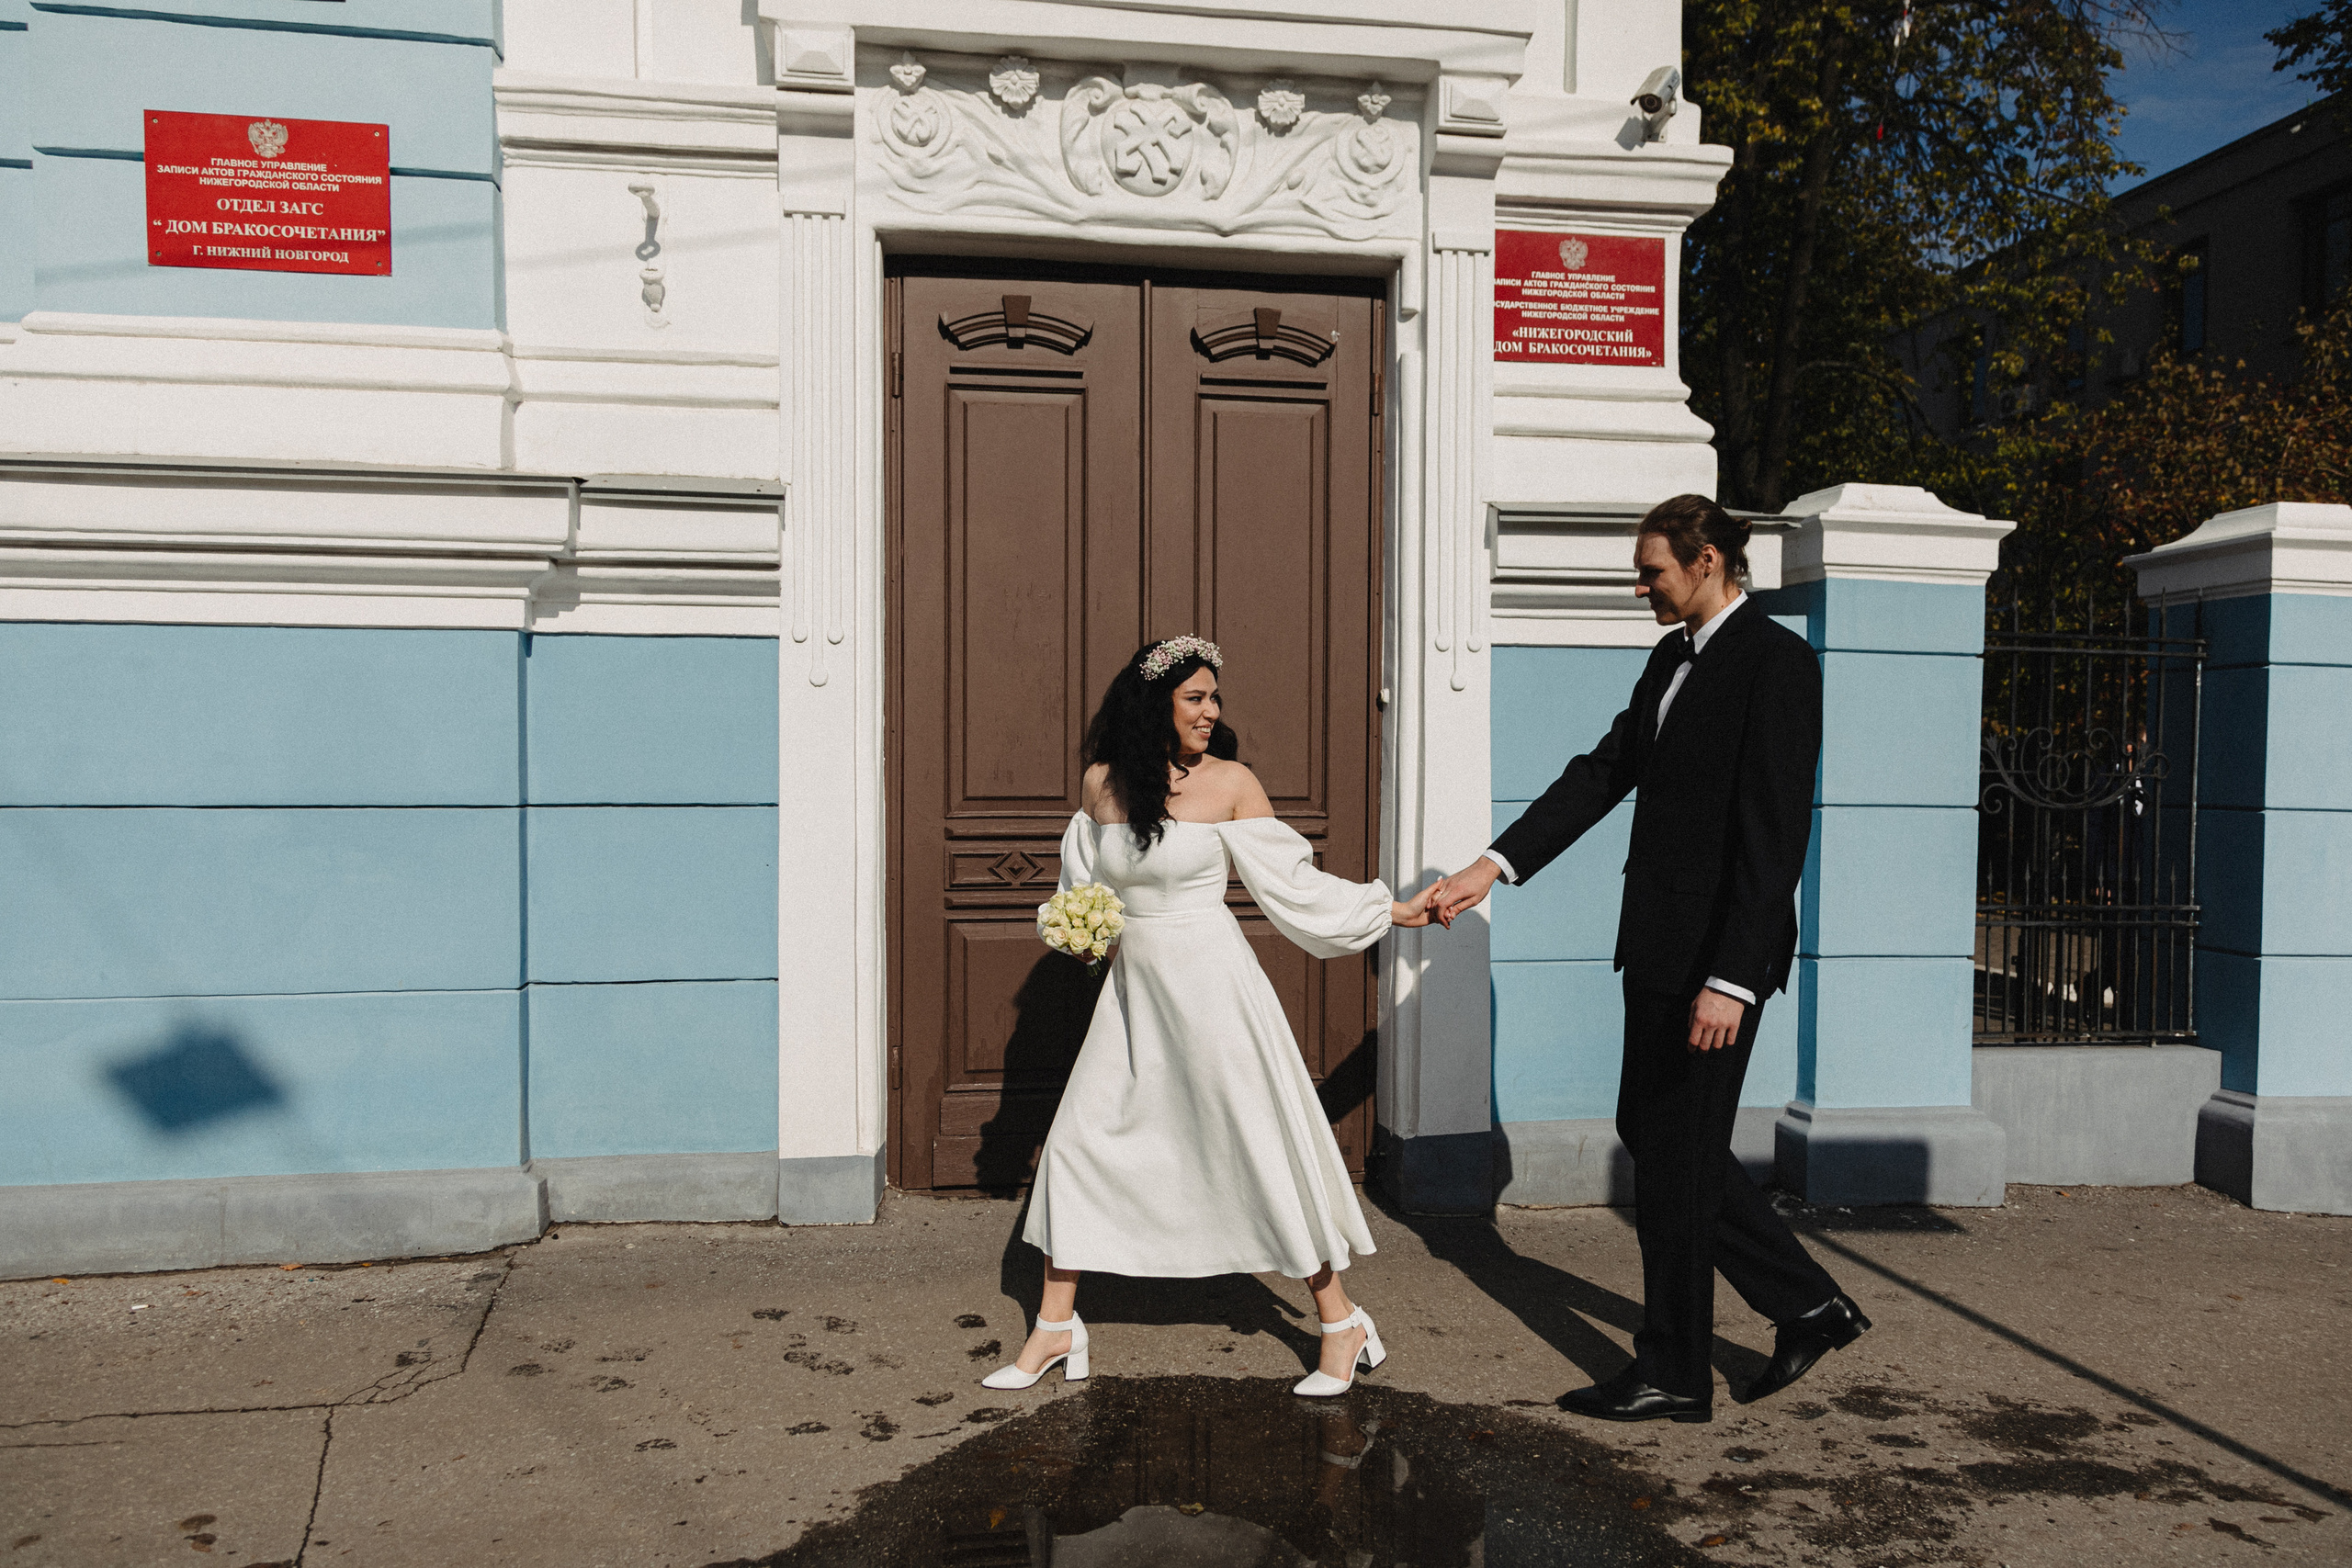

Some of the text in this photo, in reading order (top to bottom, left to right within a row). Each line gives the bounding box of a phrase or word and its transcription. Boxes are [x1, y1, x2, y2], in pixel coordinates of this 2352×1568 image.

[210, 158, 327, 172] ГЛАВНОЕ УПРАВЛЕНИЕ
[156, 164, 382, 185] ЗАПИСИ АКТОВ ГРАЖДАНСКОГО СОСТОЯНИЯ
[199, 177, 340, 192] НИЖЕГОРОДСКОЙ ОБЛАСТИ
[216, 197, 324, 216] ОТДЕЛ ЗАГС
[212, 222, 386, 242] БРАКОСОЧЕТАНИЯ”
[207, 245, 272, 259] НИЖНИЙ
[276, 249, 349, 264] НОВГОРОД
[1532, 271, 1616, 283] ГЛАВНОЕ УПРАВЛЕНИЕ
[1521, 288, 1625, 300] НИЖЕГОРОДСКОЙ ОБЛАСТИ
[1523, 279, 1548, 288] АКТОВ
[1549, 281, 1609, 291] ГРАЖДАНСКОГО
[1611, 284, 1656, 293] СОСТОЯНИЯ
[1494, 300, 1660, 316] СУДАРСТВЕННОЕ БЮДЖЕТНОЕ УЧРЕЖДЕНИЕ
[1521, 310, 1625, 322] НИЖЕГОРОДСКОЙ ОБЛАСТИ
[1512, 326, 1634, 343] «НИЖЕГОРОДСКИЙ
[1494, 341, 1653, 358] ДОМ БРАКОСОЧЕТАНИЯ»
